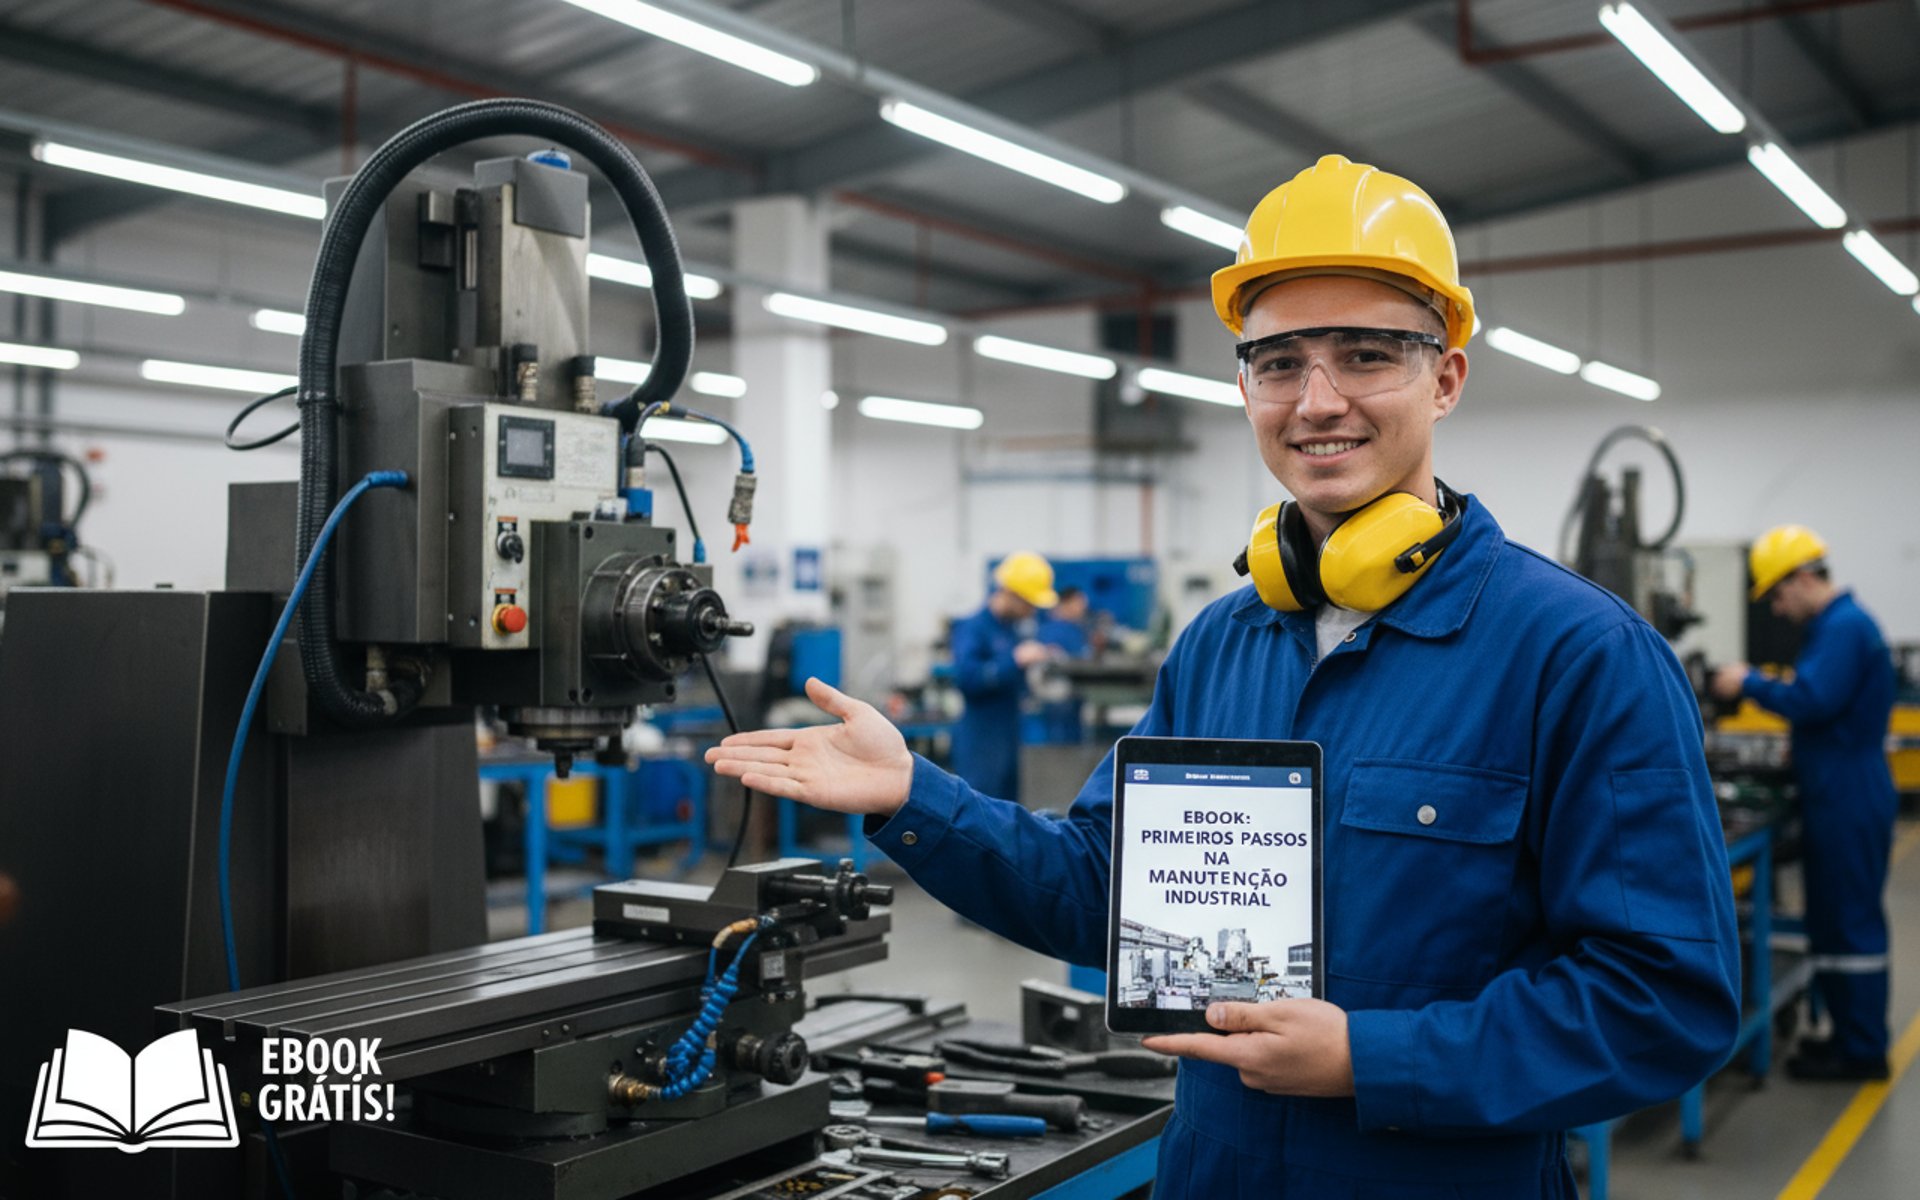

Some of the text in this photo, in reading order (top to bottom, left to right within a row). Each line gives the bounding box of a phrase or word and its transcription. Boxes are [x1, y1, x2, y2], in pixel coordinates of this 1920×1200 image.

[1183, 810, 1251, 825] EBOOK:
[1141, 829, 1308, 847] PRIMEIROS PASSOS
[1204, 851, 1230, 866] NA
[1149, 868, 1288, 890] MANUTENÇÃO
[1165, 889, 1271, 907] INDUSTRIAL
